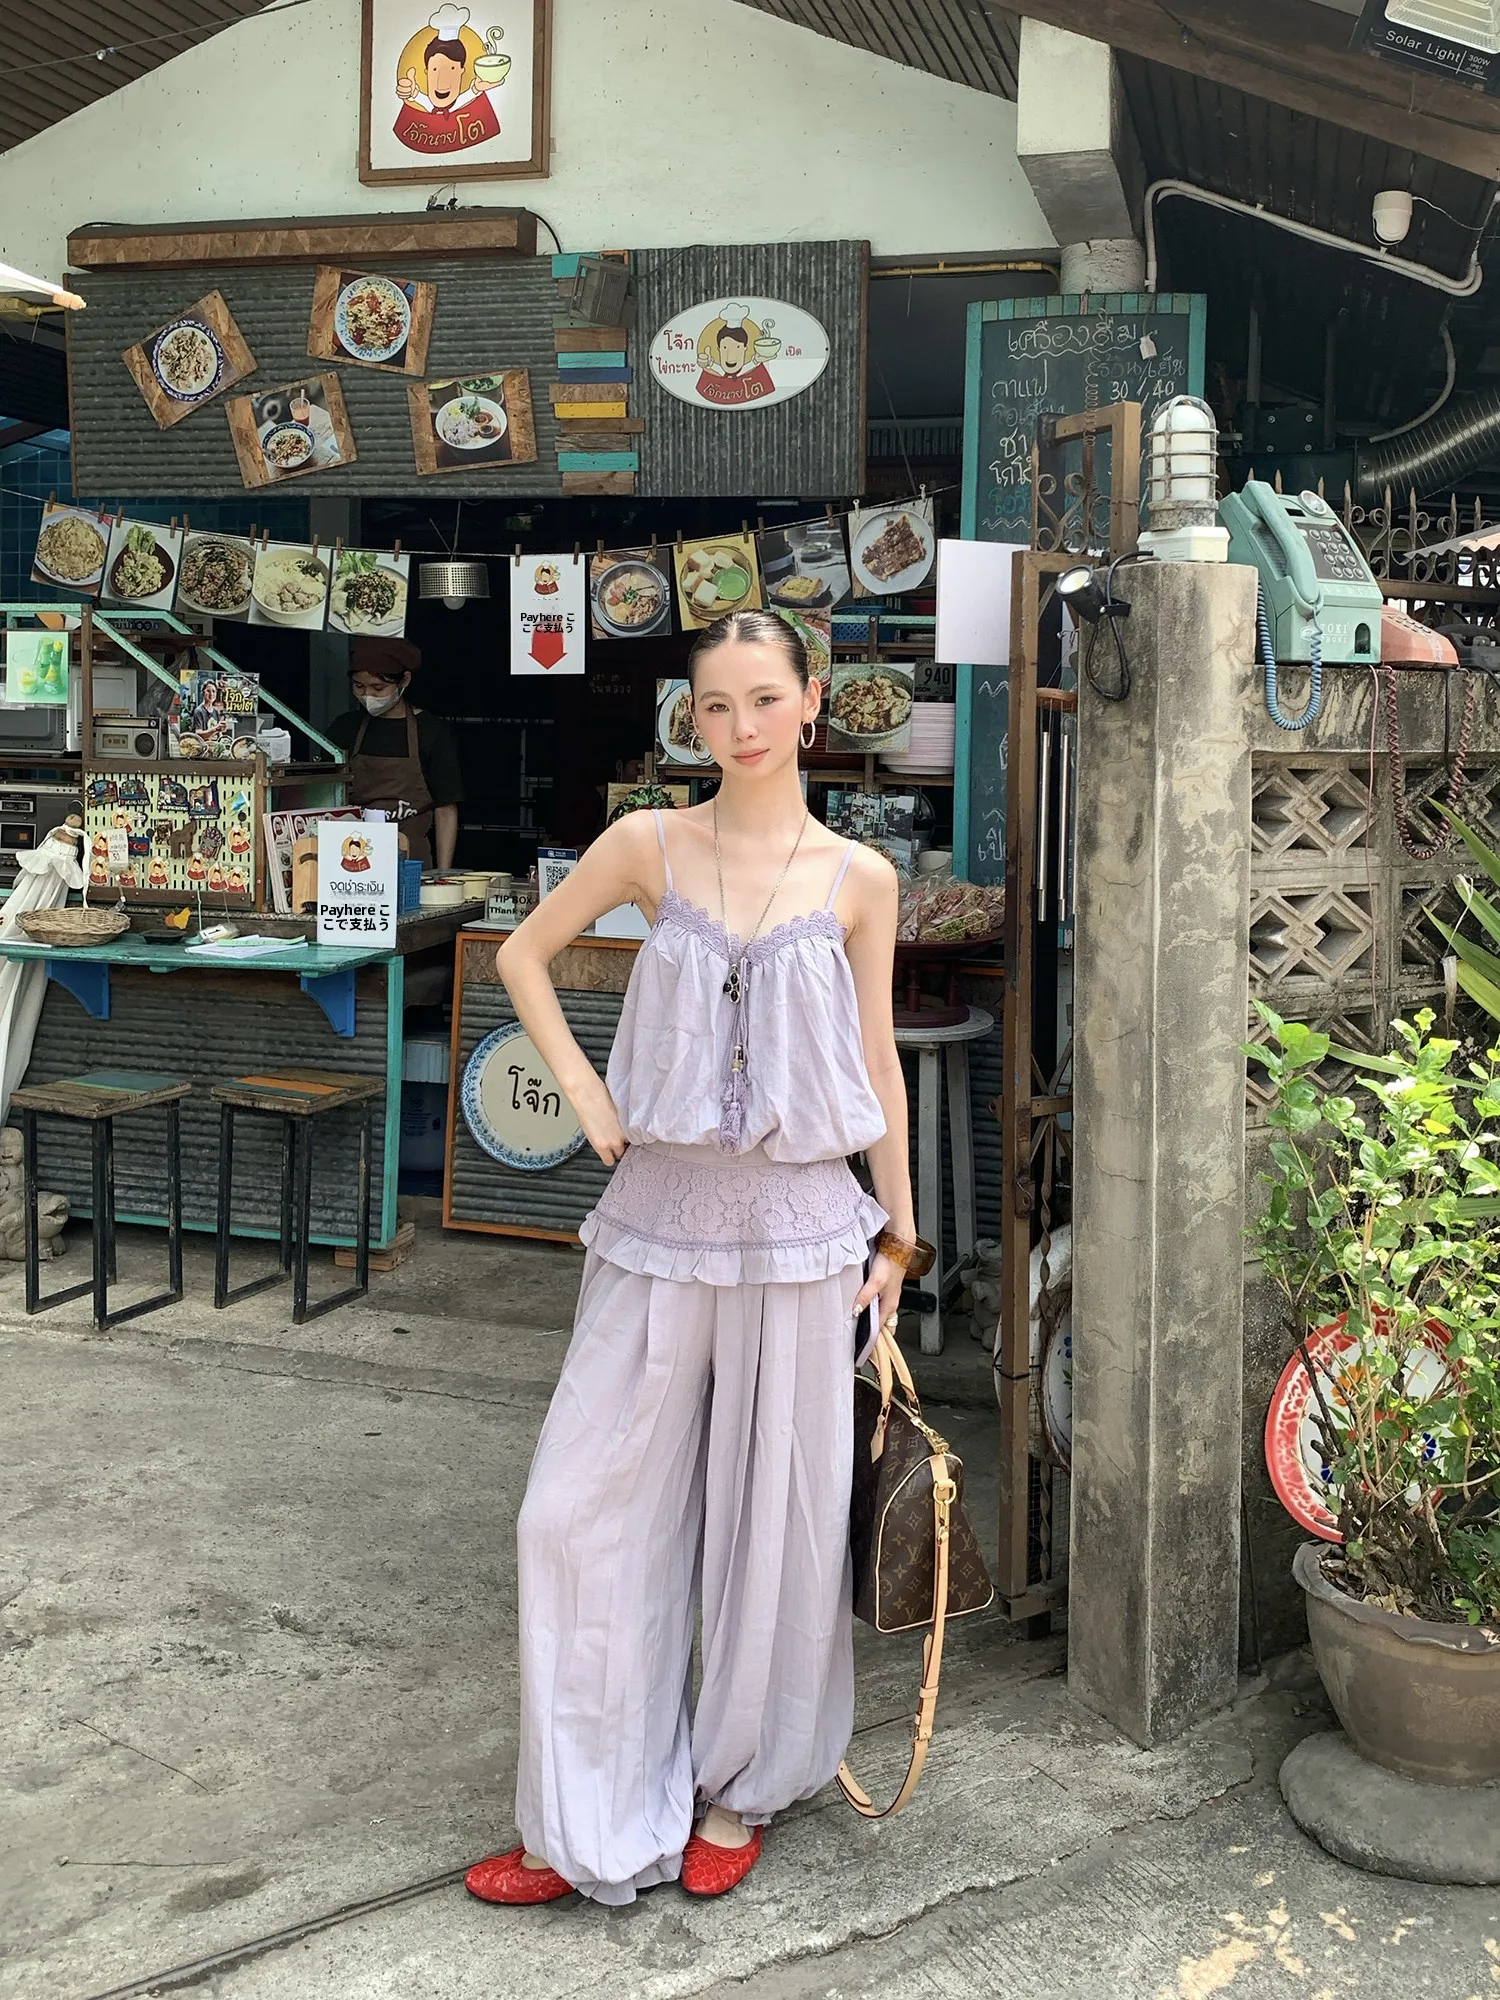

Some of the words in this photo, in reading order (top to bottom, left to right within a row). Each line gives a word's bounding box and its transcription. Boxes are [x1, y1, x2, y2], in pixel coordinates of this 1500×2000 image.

[1385, 30, 1421, 50] Solar
[1426, 43, 1461, 63] Light
[1468, 54, 1491, 67] 300W
[402, 113, 486, 146] โจ๊กนายโต
[663, 329, 695, 351] โจ๊ก
[785, 345, 802, 357] เปิด
[655, 356, 696, 375] ไข่กะทะ
[702, 377, 765, 400] โจ๊กนายโต
[1109, 380, 1129, 400] 30
[1152, 378, 1175, 399] 40
[520, 612, 563, 623] Payhere
[566, 613, 575, 622] こ
[522, 623, 574, 633] こで支払う
[924, 667, 950, 686] 940
[494, 894, 510, 903] TIP
[513, 896, 532, 905] BOX
[320, 904, 375, 918] Payhere
[379, 904, 390, 917] こ
[489, 906, 518, 915] Thank
[519, 908, 532, 917] yo
[323, 918, 389, 931] こで支払う
[508, 1065, 561, 1117] โจ๊ก
